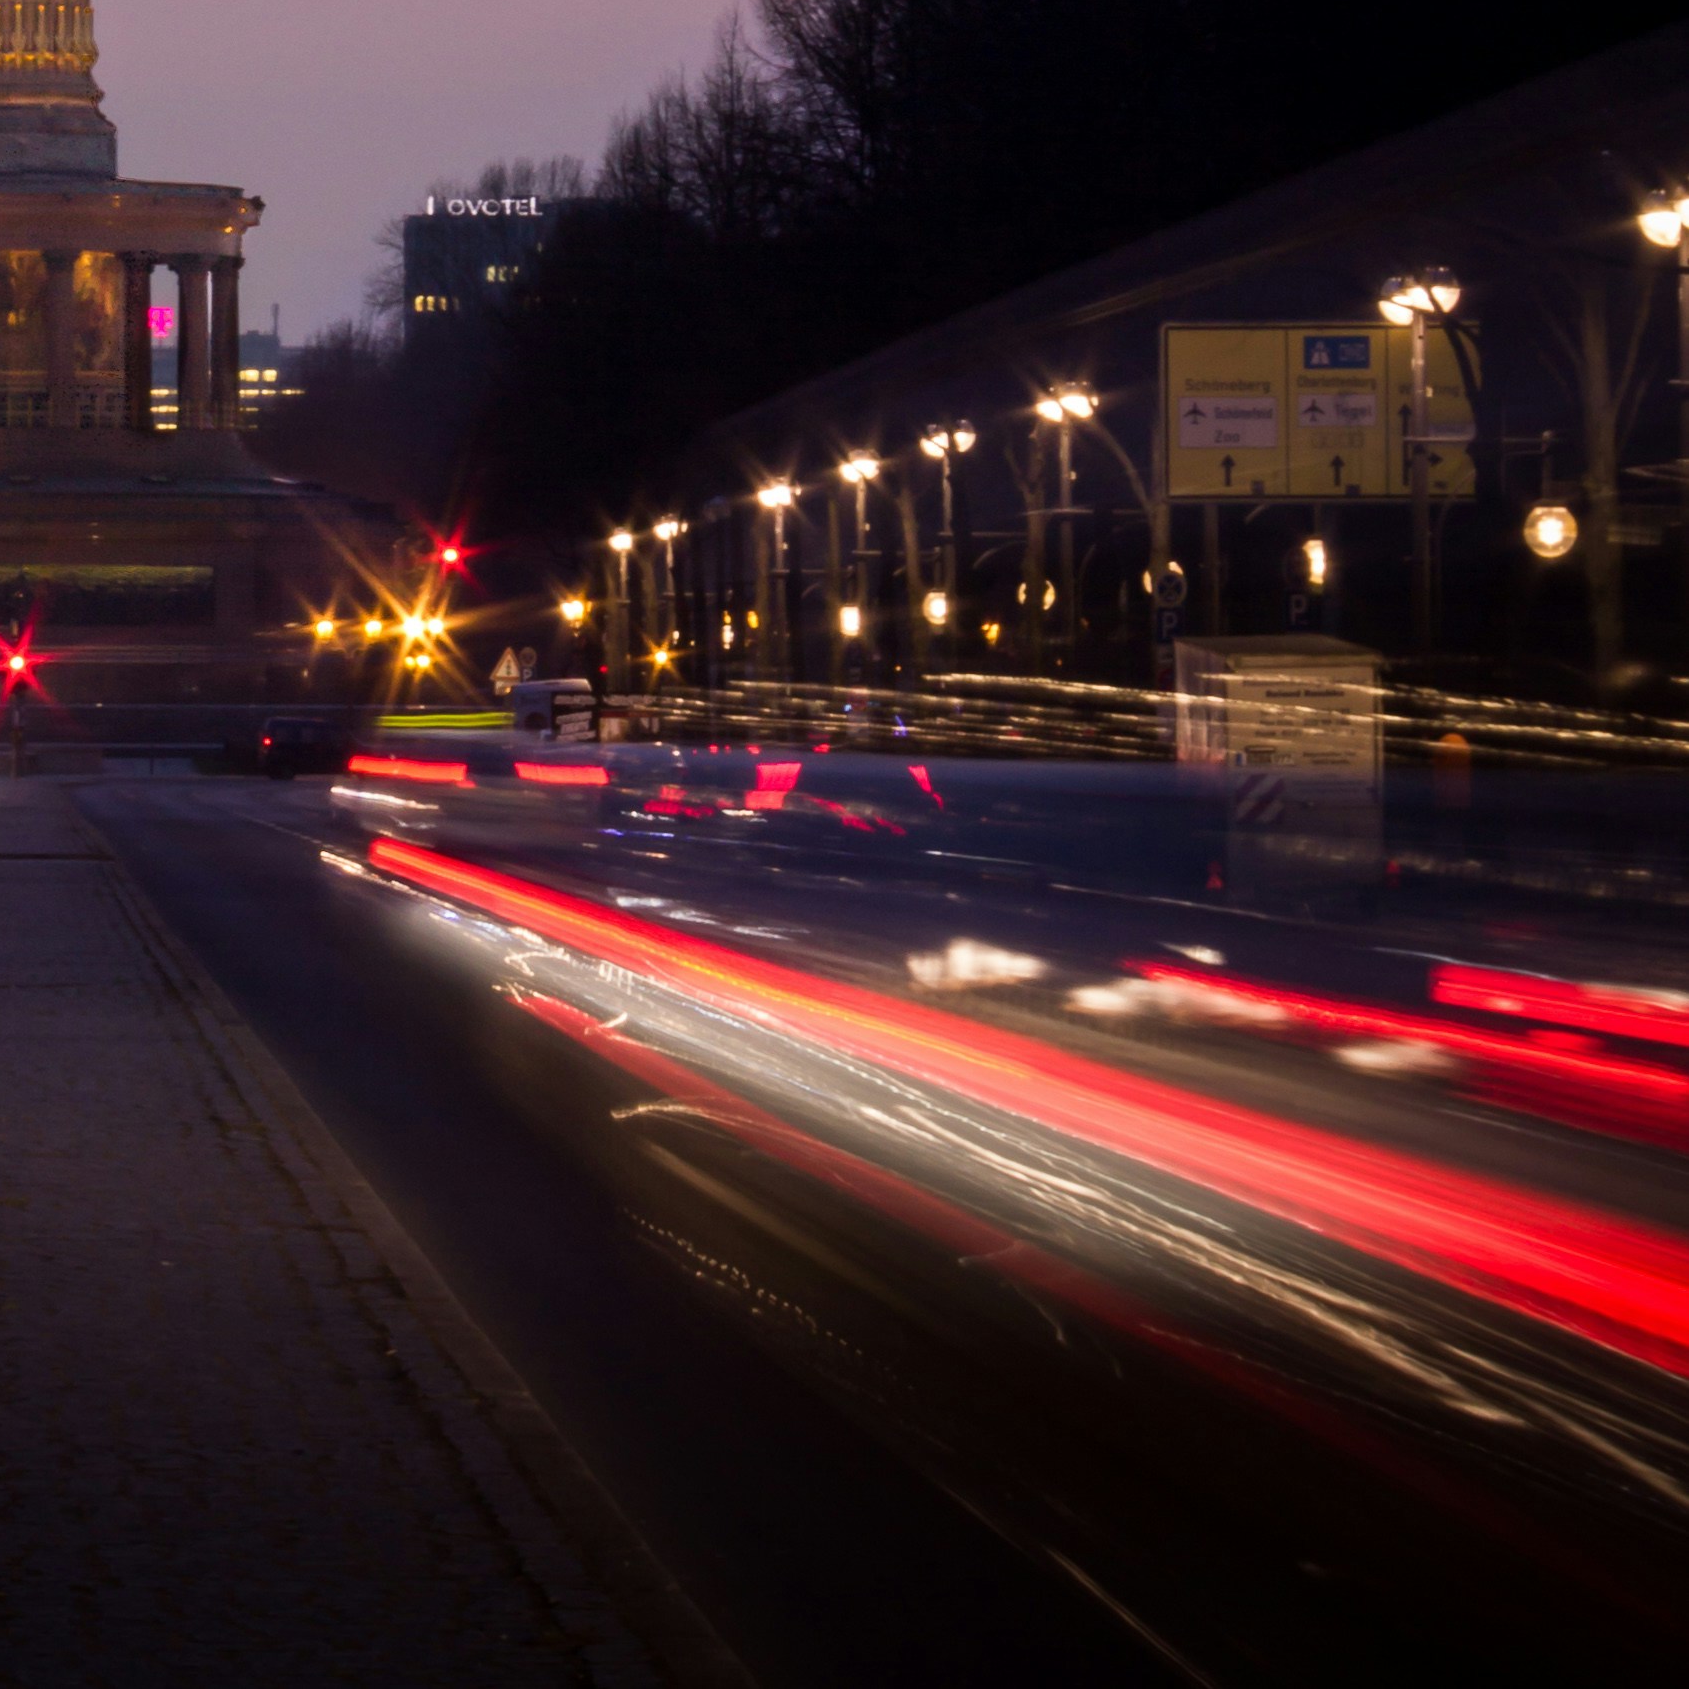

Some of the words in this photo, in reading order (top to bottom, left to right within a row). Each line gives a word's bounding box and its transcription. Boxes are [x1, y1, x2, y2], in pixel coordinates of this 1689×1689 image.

[1185, 378, 1271, 394] Schöneberg
[1335, 403, 1372, 421] Tegel
[1214, 429, 1241, 443] Zoo
[1292, 594, 1307, 625] P
[1163, 613, 1177, 639] P
